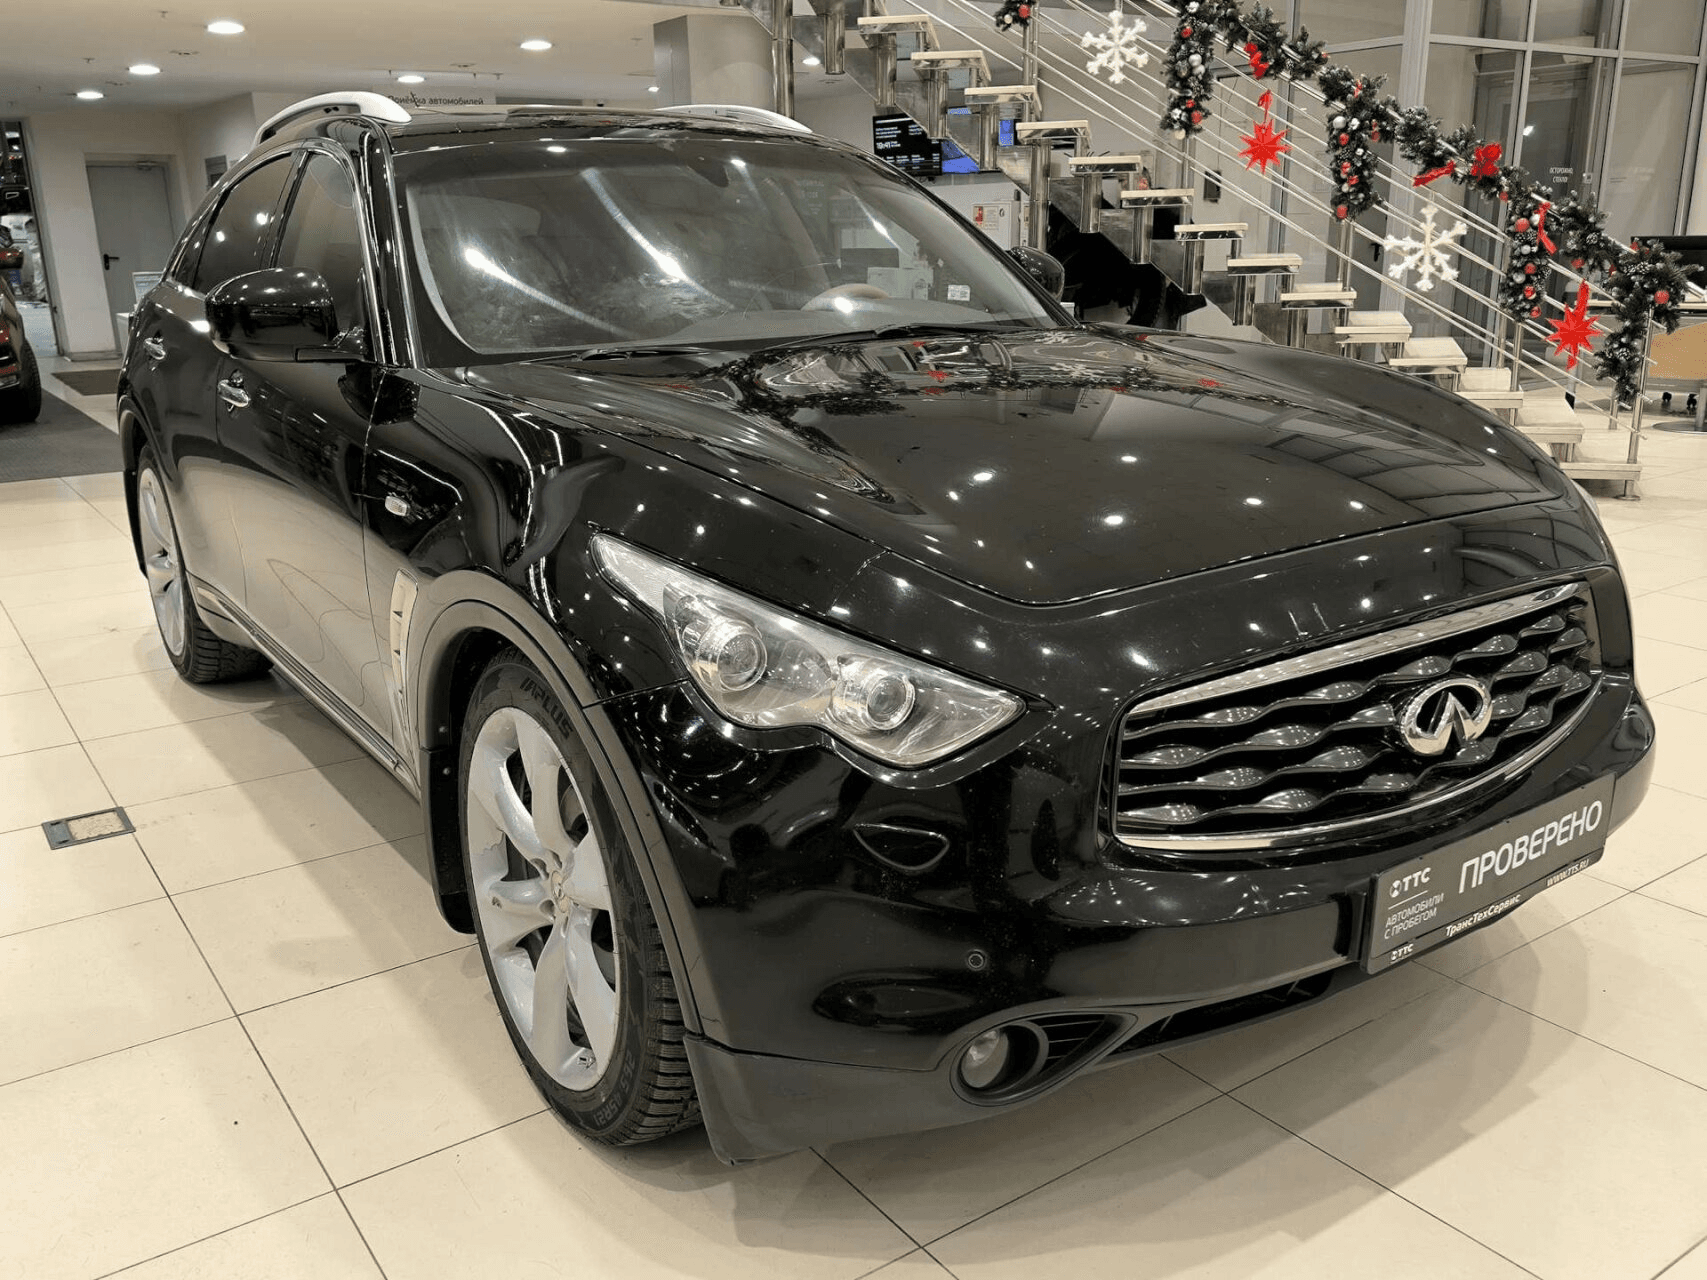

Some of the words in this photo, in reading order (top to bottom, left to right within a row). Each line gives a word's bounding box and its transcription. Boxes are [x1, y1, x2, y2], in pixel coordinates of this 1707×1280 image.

[429, 96, 484, 105] автомобилей
[1458, 800, 1603, 894] ПРОВЕРЕНО
[1384, 929, 1391, 939] С
[1391, 907, 1437, 936] ПРОБЕГОМ
[1385, 892, 1444, 928] АВТОМОБИЛИ
[1446, 894, 1521, 937] ТрансТехСервис
